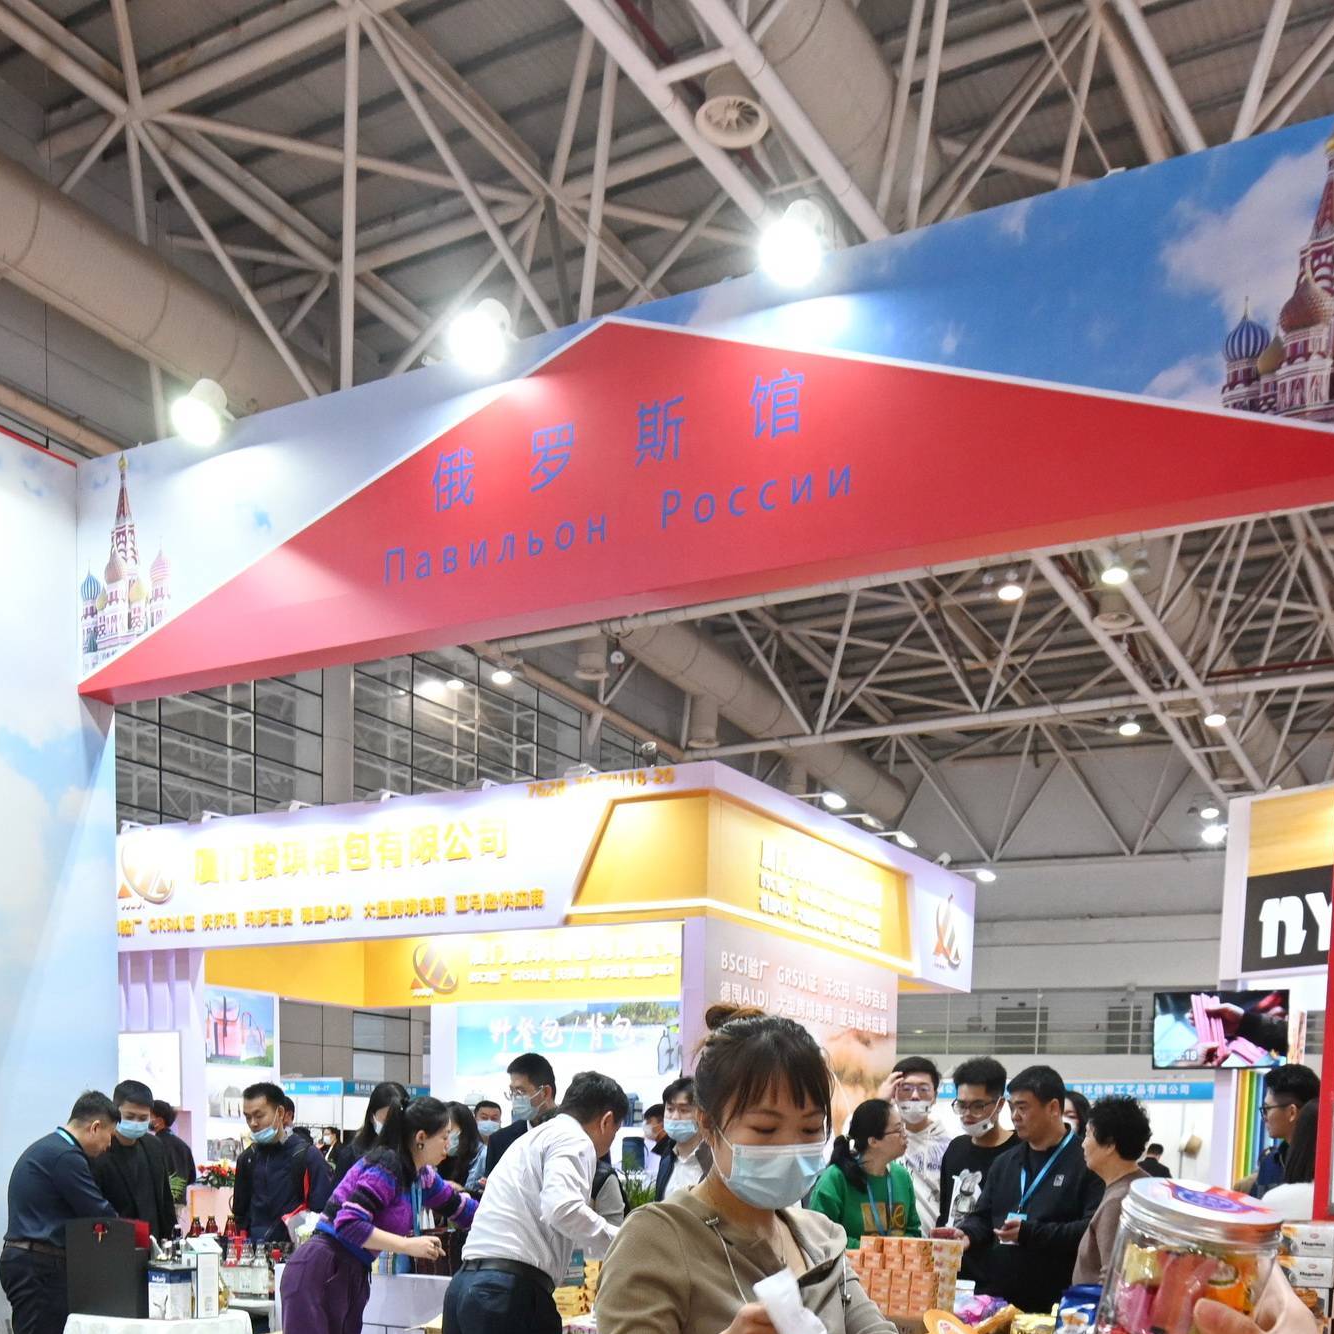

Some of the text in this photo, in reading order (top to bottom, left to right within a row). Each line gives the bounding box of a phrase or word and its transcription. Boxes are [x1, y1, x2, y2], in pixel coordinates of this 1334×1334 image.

[432, 367, 806, 514] 俄罗斯馆
[383, 464, 855, 585] Павильон России
